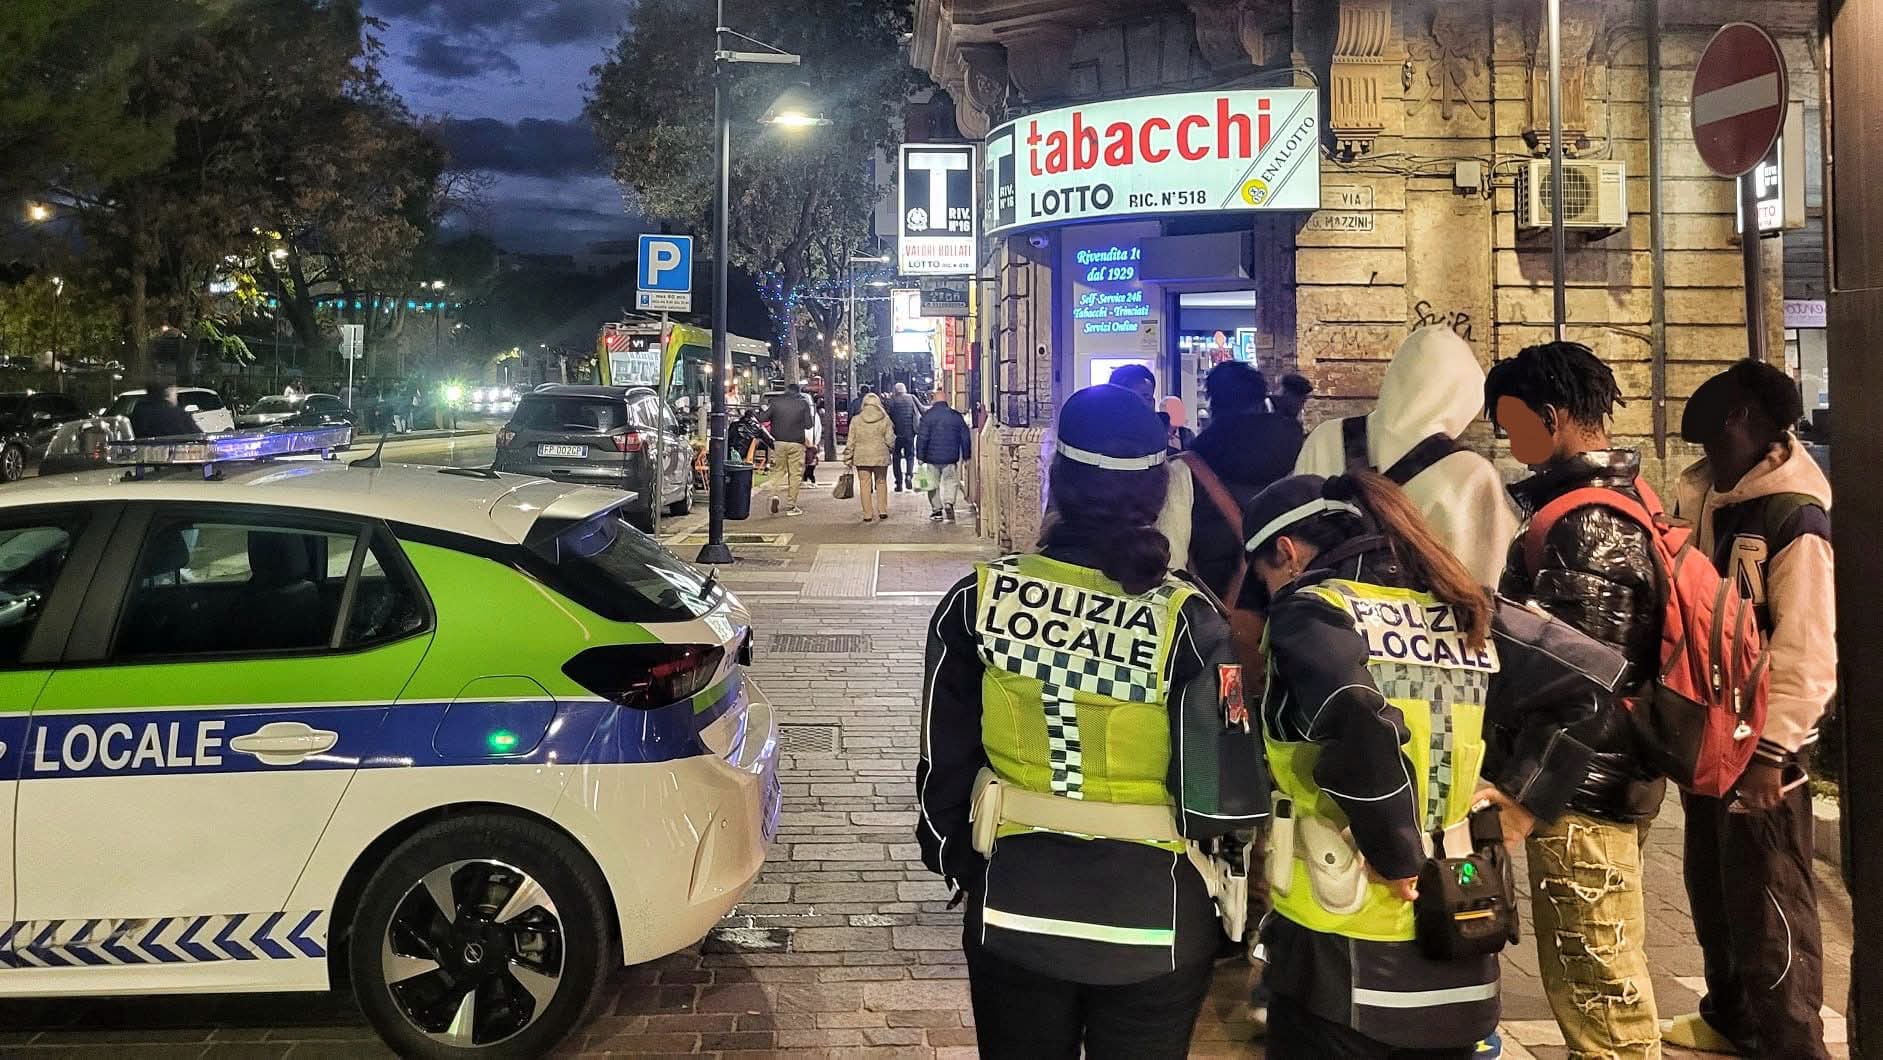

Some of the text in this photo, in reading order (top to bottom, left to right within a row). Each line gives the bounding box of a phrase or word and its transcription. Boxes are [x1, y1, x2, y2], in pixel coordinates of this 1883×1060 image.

[1027, 97, 1271, 176] tabacchi
[1261, 117, 1315, 183] ENALOTTO
[908, 153, 968, 229] T
[1342, 193, 1361, 205] VIA
[1031, 183, 1114, 217] LOTTO
[1129, 193, 1158, 208] RIC.
[948, 207, 971, 220] RIV.
[1325, 216, 1368, 228] MAZZINI
[647, 241, 681, 286] P
[908, 260, 940, 268] LOTTO
[1077, 247, 1128, 265] Rivendita
[1087, 266, 1134, 281] dal 1929
[1080, 292, 1126, 306] Self-Service
[1073, 306, 1107, 318] Tabacchi
[1113, 304, 1150, 317] Trinciati
[1084, 320, 1138, 333] Servizi Online
[632, 340, 644, 348] V1
[992, 574, 1158, 636] POLIZIA
[985, 605, 1157, 670] LOCALE
[34, 720, 225, 772] LOCALE
